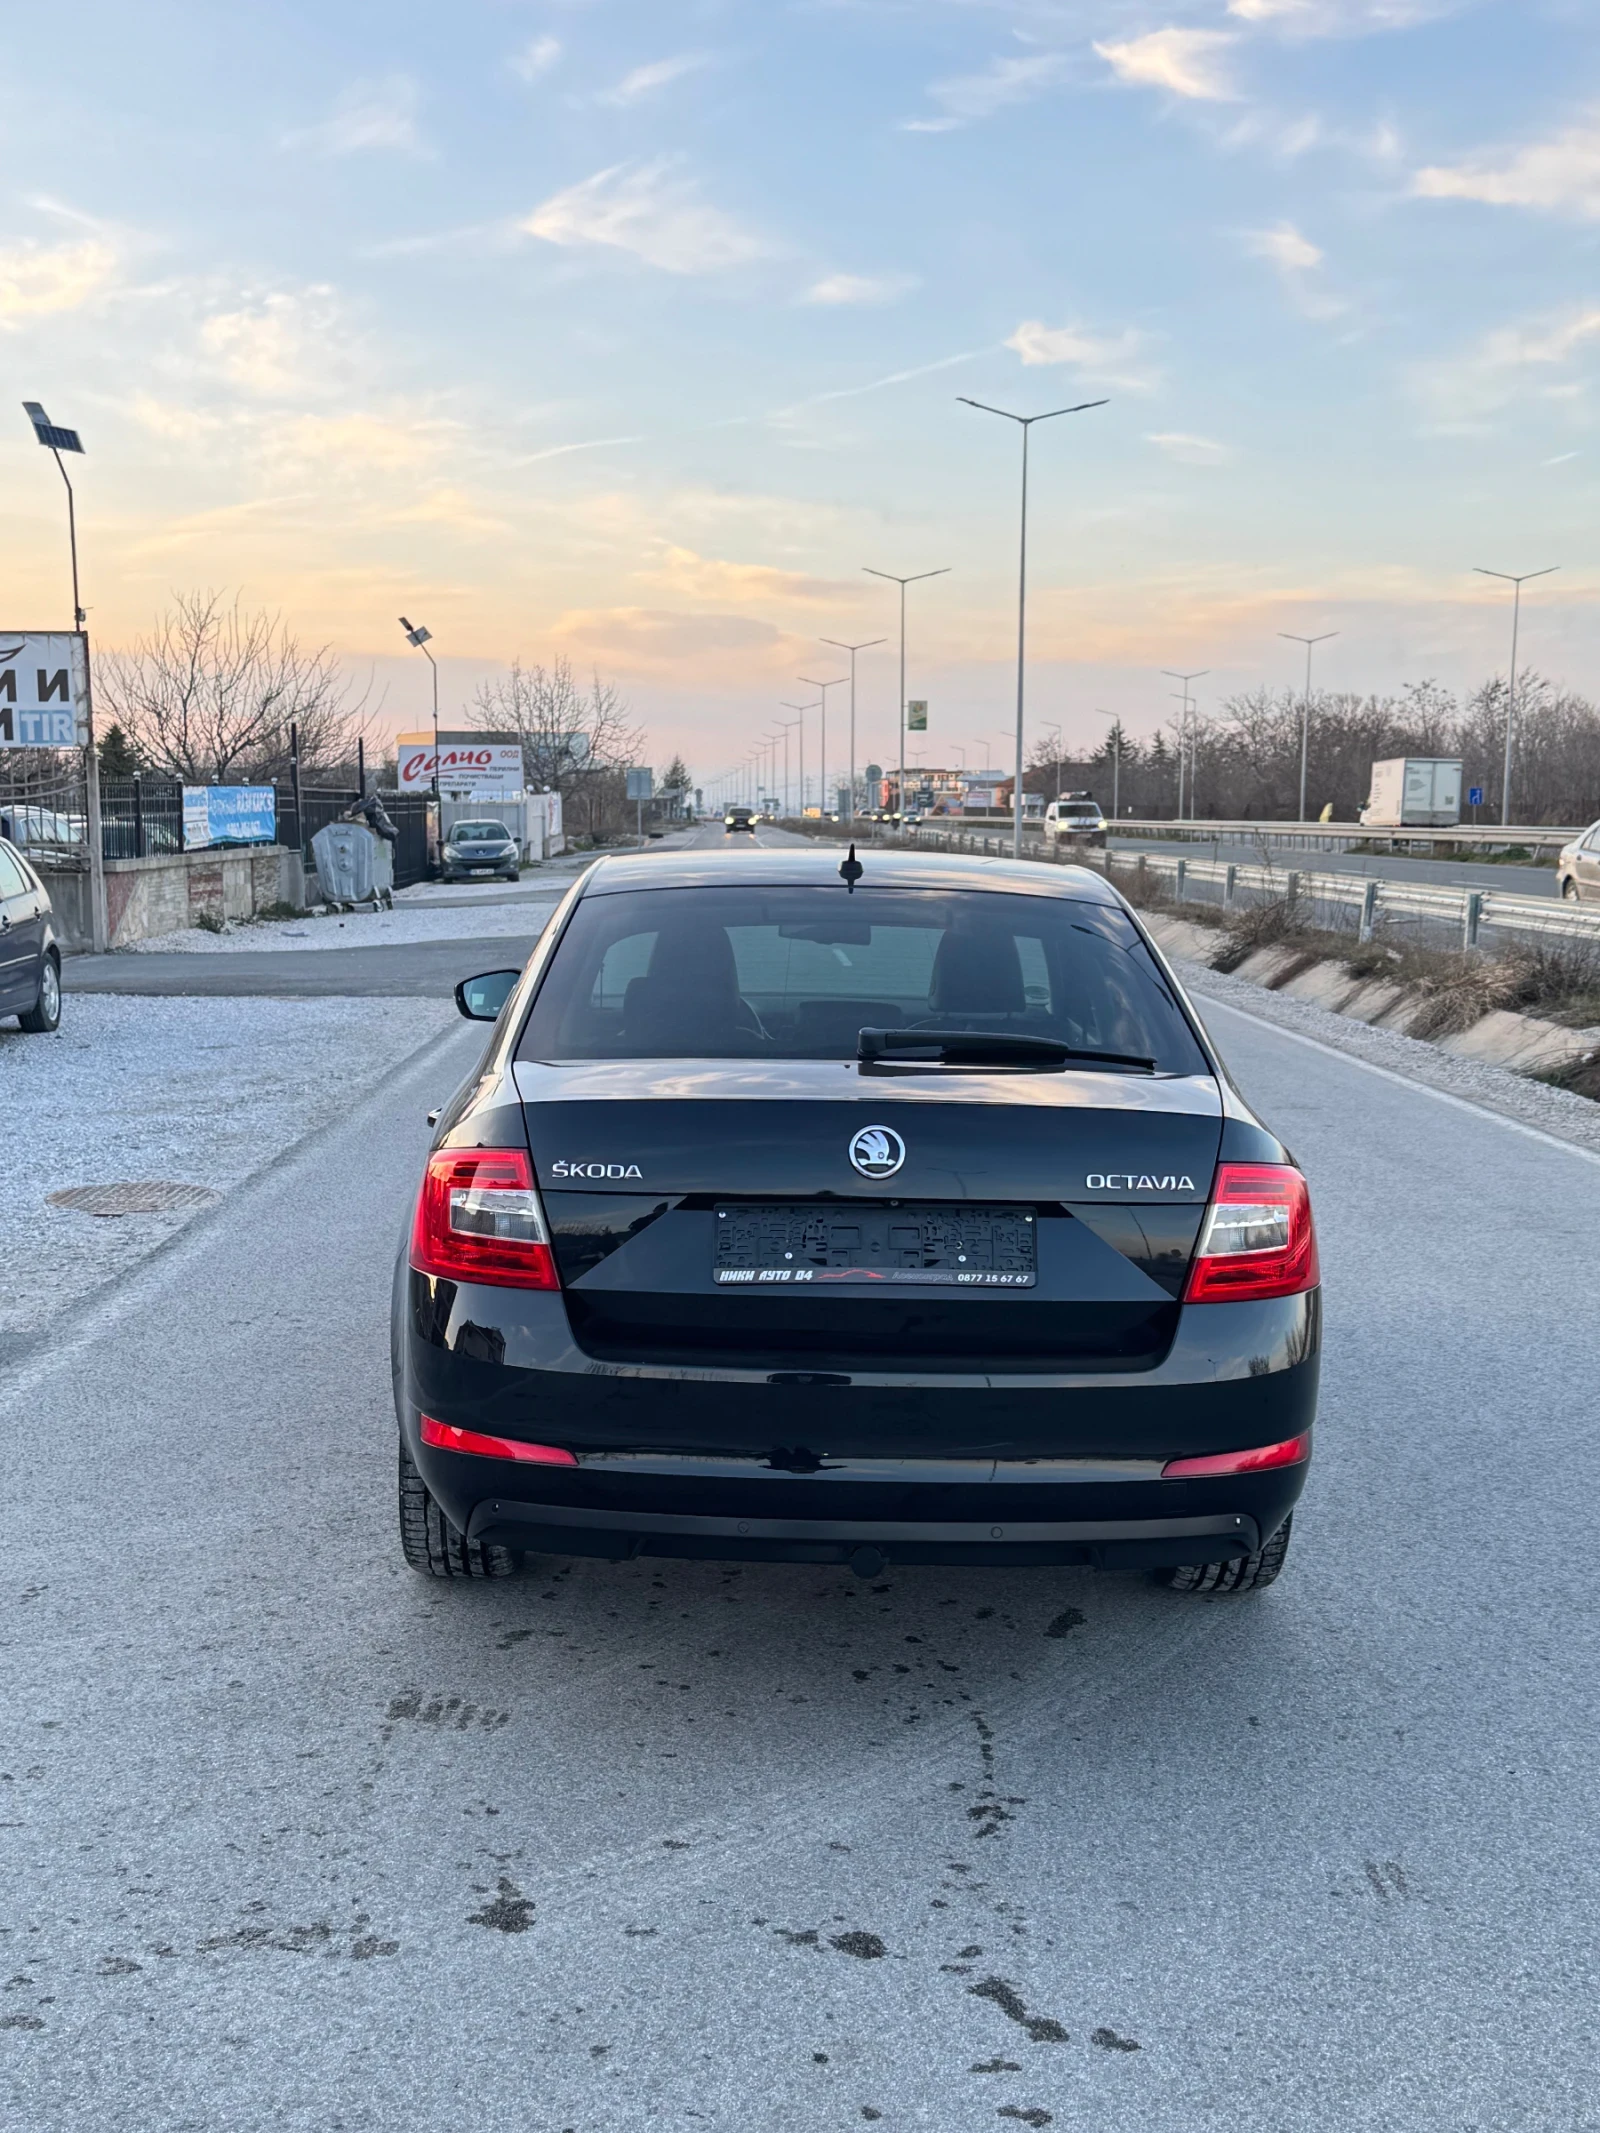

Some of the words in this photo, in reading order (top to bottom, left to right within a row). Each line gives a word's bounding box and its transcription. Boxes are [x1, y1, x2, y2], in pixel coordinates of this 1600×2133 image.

[20, 713, 73, 741] TIR
[499, 750, 520, 759] ООД
[551, 1159, 644, 1180] ŠKODA
[1085, 1173, 1196, 1191] OCTAVIA
[719, 1270, 755, 1282] НИКИ
[758, 1270, 792, 1281] АУТО
[794, 1270, 814, 1281] 04
[957, 1273, 983, 1282] 0877
[985, 1274, 998, 1283] 15
[1000, 1274, 1013, 1283] 67
[1015, 1275, 1029, 1284] 67
